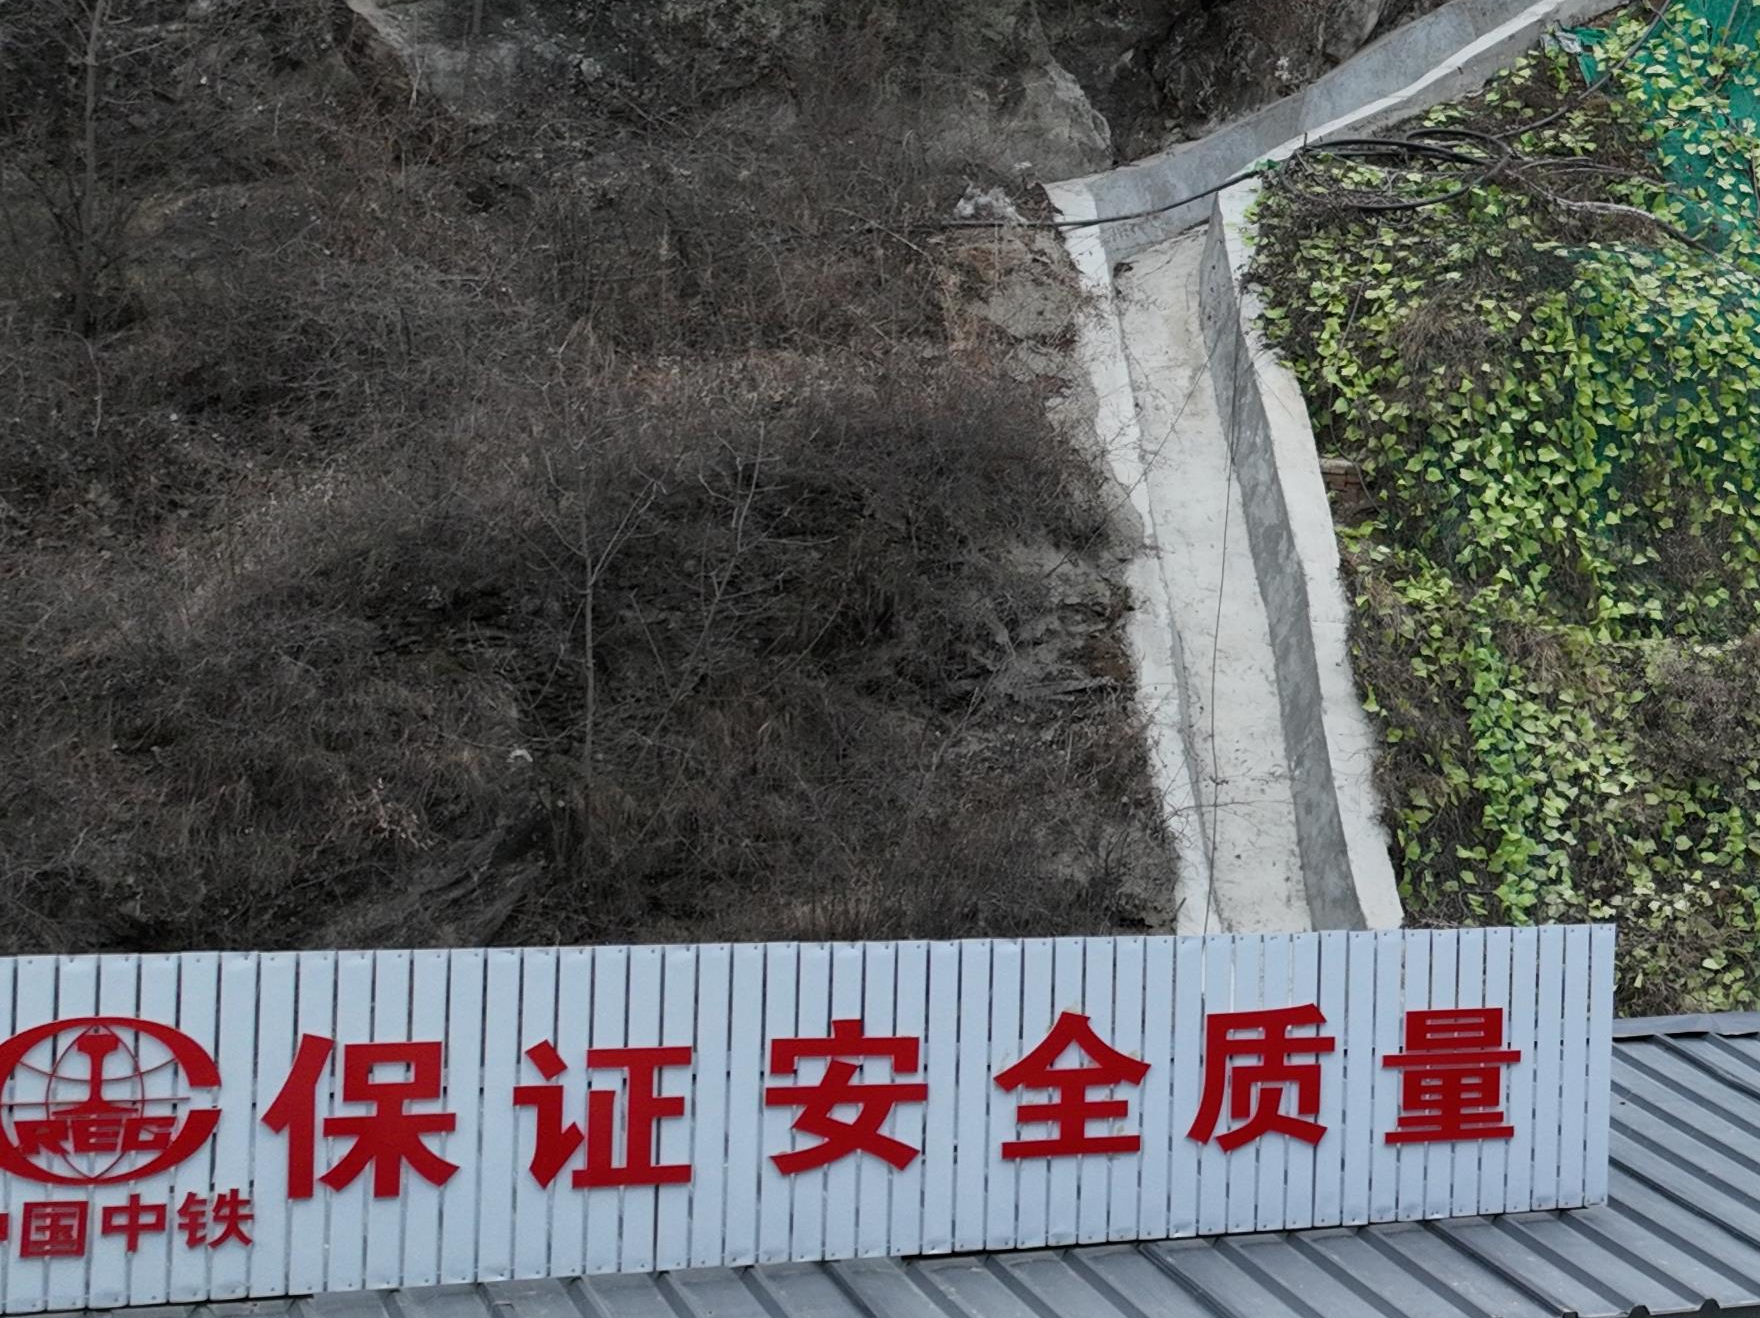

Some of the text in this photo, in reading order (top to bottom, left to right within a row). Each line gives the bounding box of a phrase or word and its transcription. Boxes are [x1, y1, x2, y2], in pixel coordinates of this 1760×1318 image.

[262, 1003, 1521, 1199] 保证安全质量
[0, 1188, 255, 1258] 国中铁
